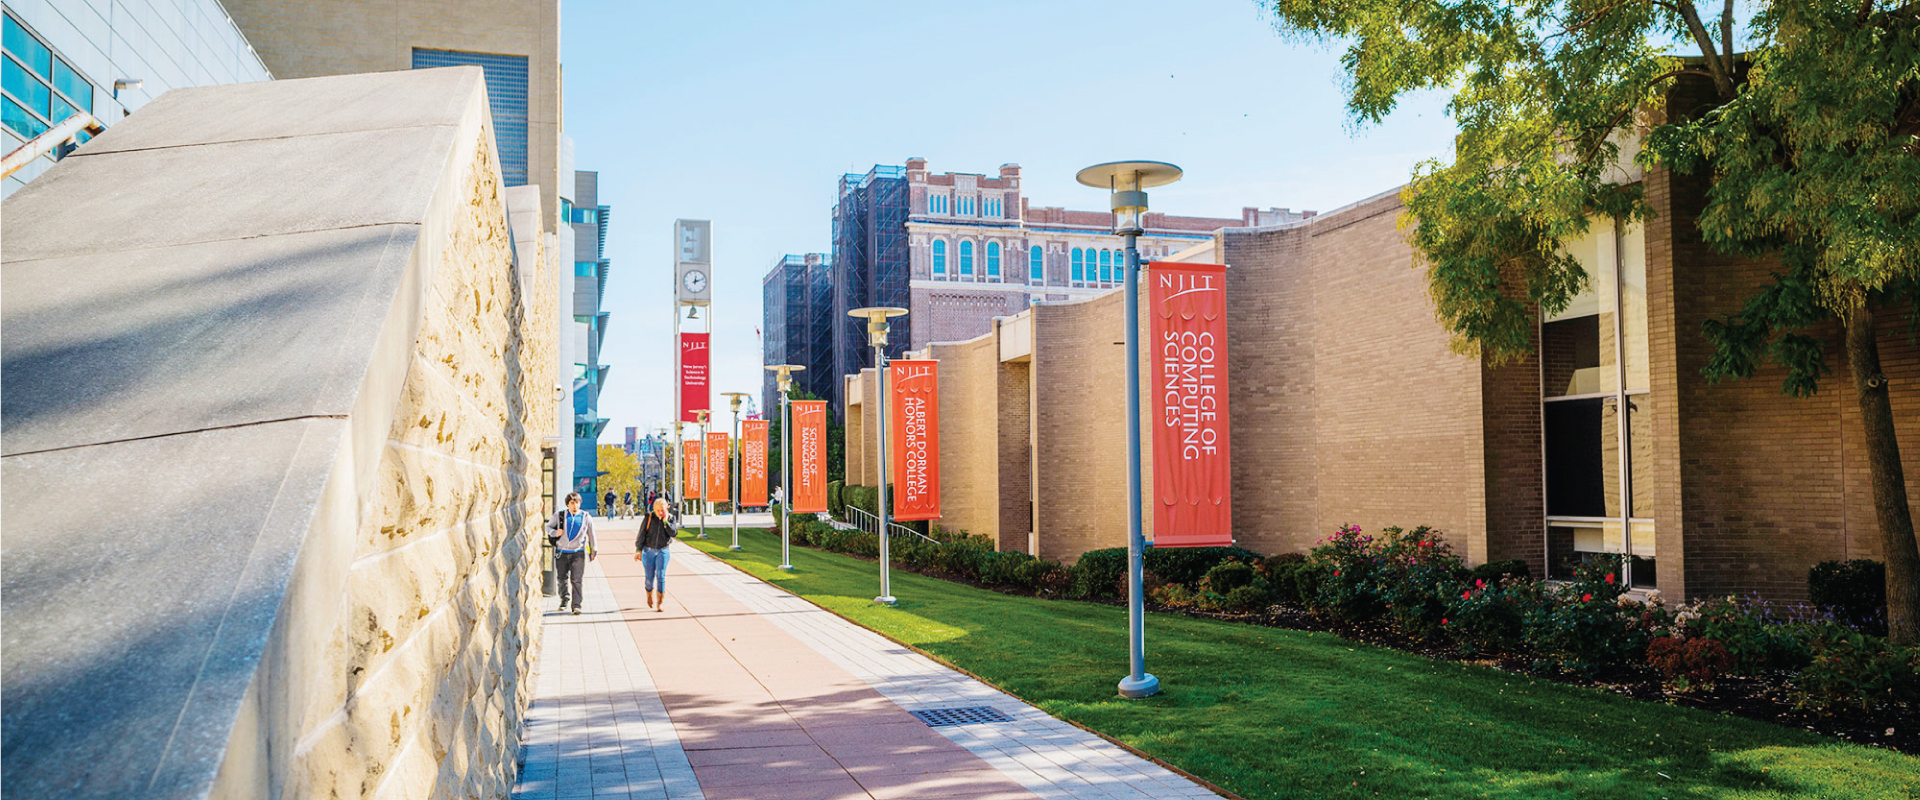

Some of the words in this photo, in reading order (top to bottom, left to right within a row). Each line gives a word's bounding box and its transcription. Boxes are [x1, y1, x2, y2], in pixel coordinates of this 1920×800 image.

[1160, 274, 1213, 292] NJIT
[897, 366, 930, 379] NJIT
[1164, 331, 1180, 427] SCIENCES
[1200, 332, 1216, 421] COLLEGE
[796, 405, 820, 414] NJIT
[916, 398, 926, 438] ALBERT
[1181, 332, 1199, 460] COMPUTING
[905, 398, 916, 448] HONORS
[1201, 428, 1216, 455] OF
[758, 470, 763, 479] OF
[802, 428, 810, 487] MANAGEMENT
[810, 464, 818, 475] OF
[906, 451, 916, 502] COLLEGE
[916, 441, 926, 494] DORMAN
